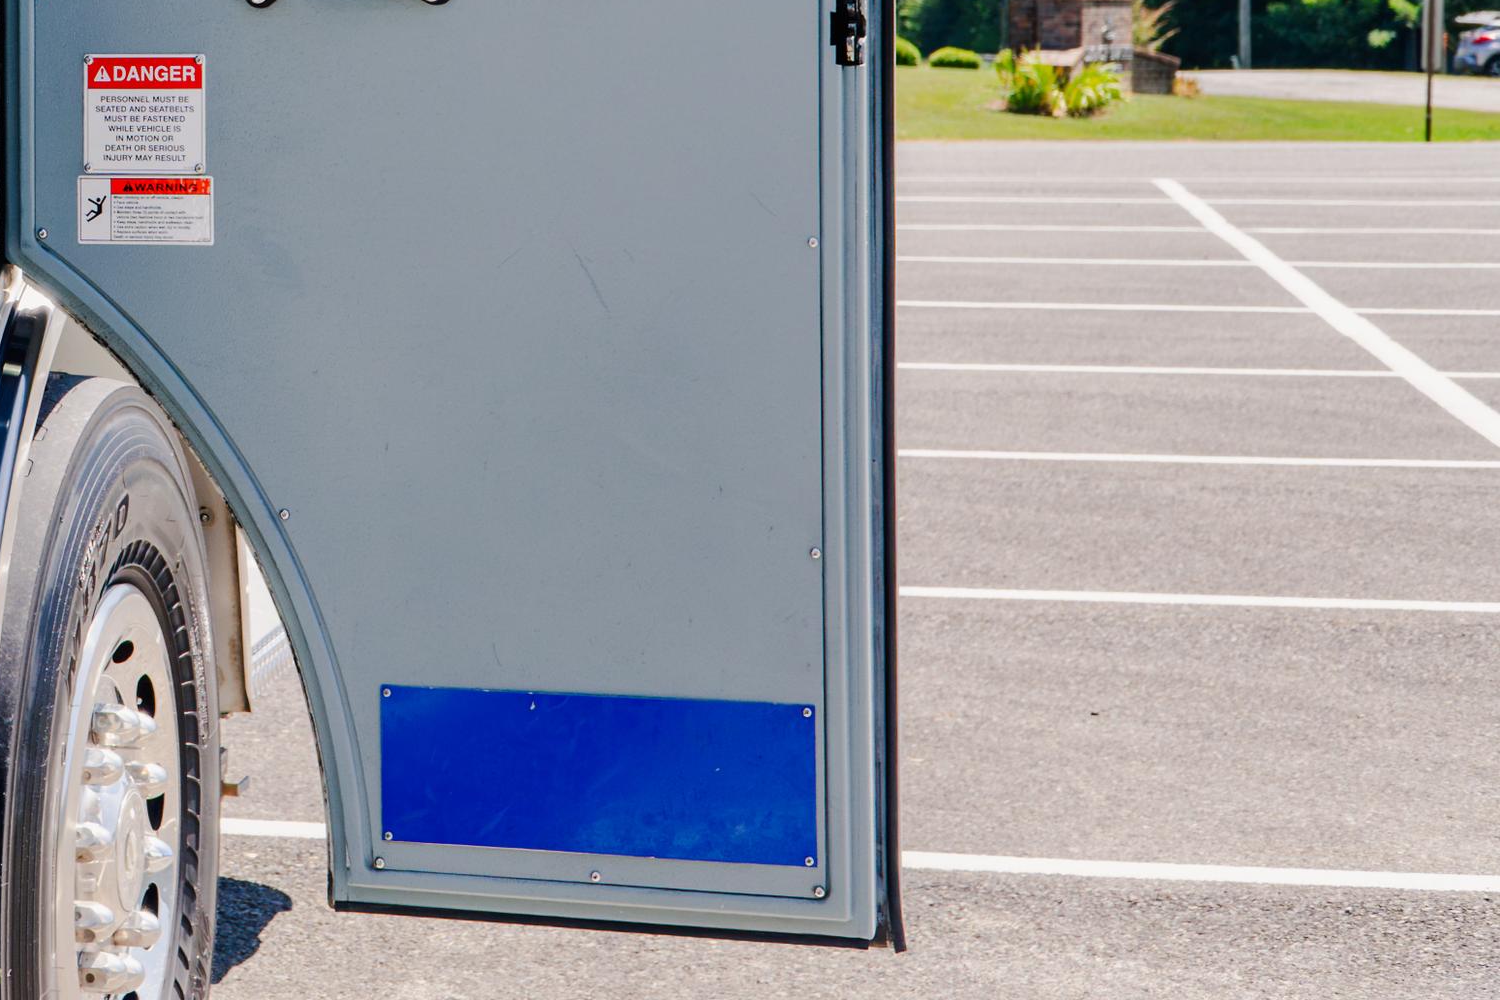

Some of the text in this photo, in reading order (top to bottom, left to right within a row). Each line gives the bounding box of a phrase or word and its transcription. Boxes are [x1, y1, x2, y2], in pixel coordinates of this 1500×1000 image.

[113, 65, 196, 82] DANGER
[95, 105, 195, 113] SEATED AND SEATBELTS
[134, 183, 198, 192] WARNING
